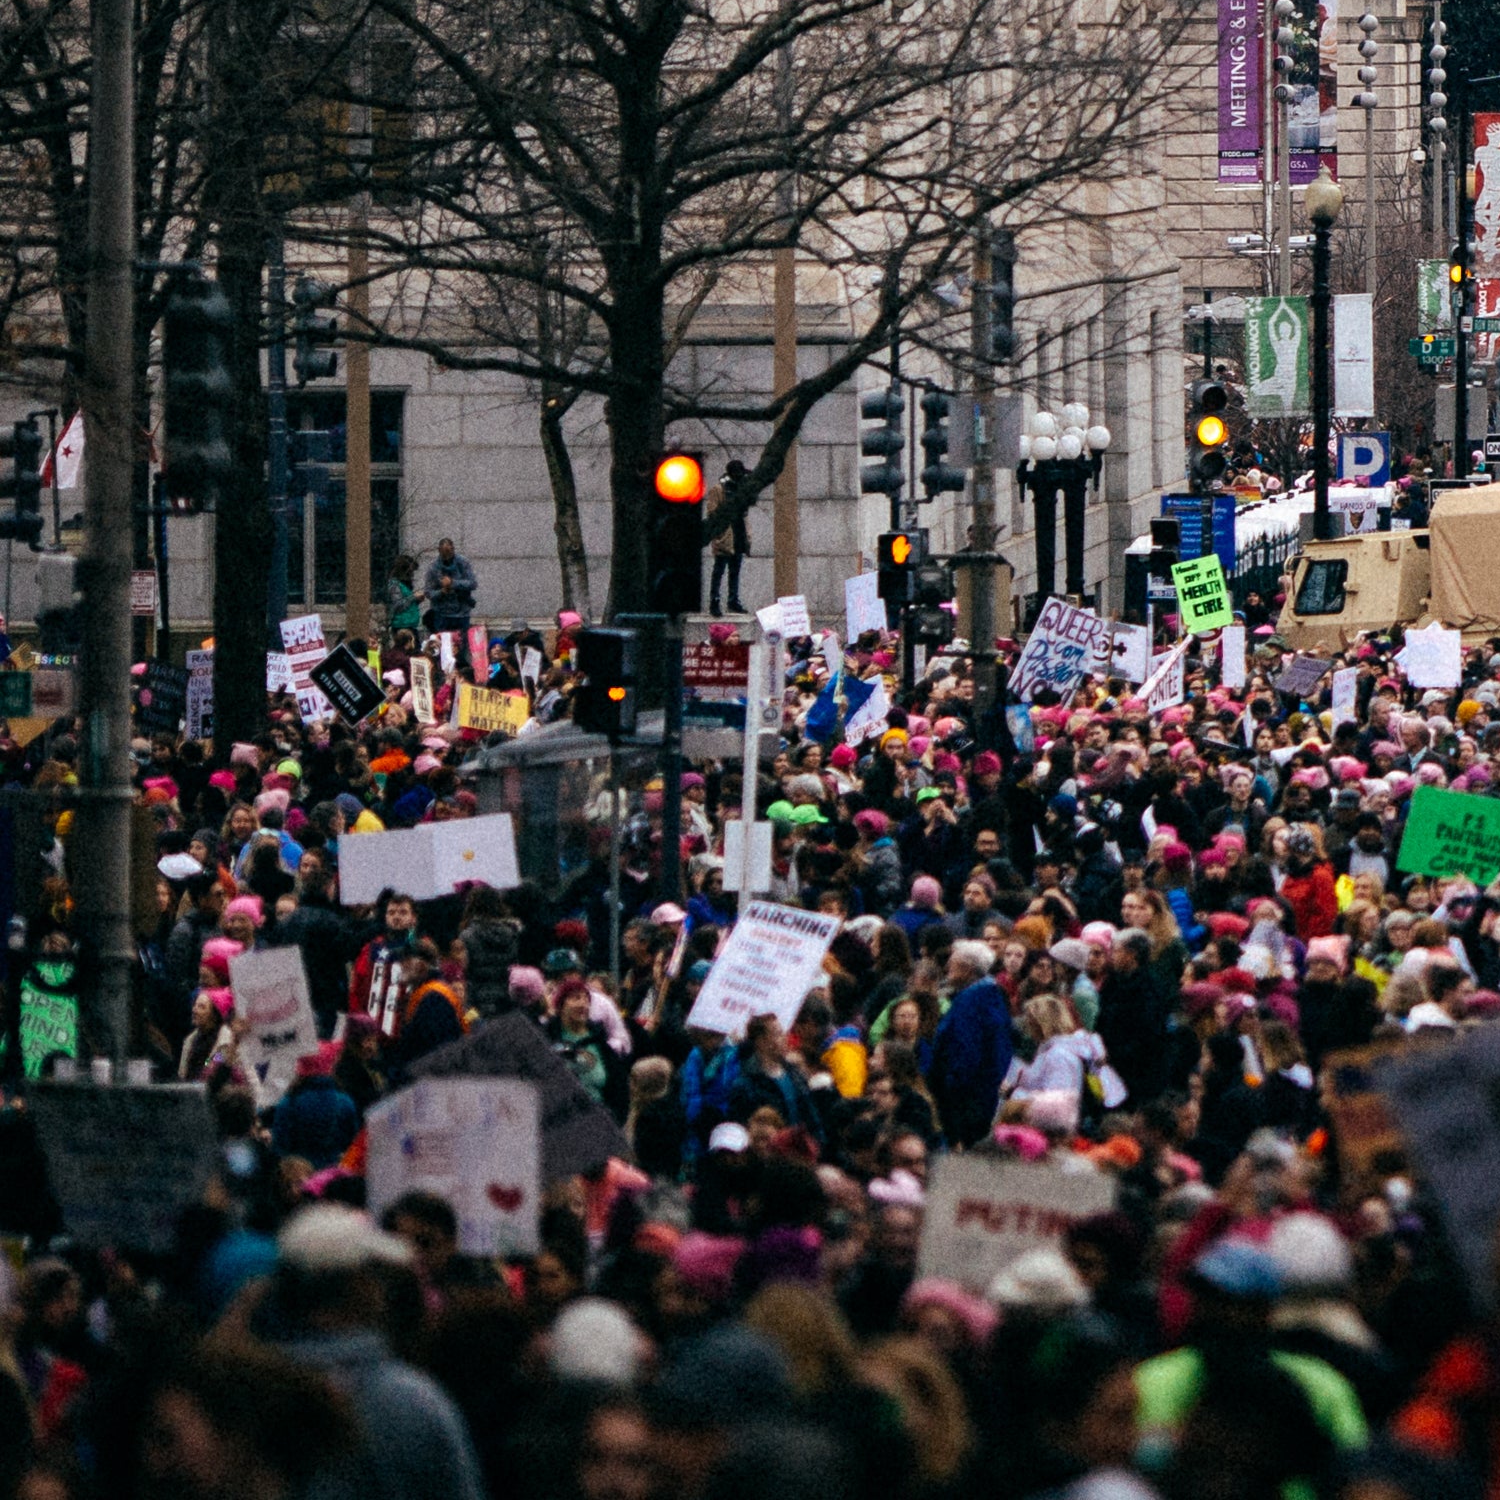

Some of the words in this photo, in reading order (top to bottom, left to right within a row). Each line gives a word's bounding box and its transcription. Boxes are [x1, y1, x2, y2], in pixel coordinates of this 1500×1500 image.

[1230, 12, 1246, 30] &
[1230, 33, 1246, 128] MEETINGS
[1290, 161, 1308, 169] GSA
[1248, 318, 1260, 390] DOWNTOWN
[1422, 341, 1433, 354] D
[1422, 356, 1444, 365] 1300
[1343, 436, 1386, 482] P
[1341, 501, 1368, 511] HANDS
[1184, 573, 1201, 585] OFF
[1206, 568, 1218, 579] MY
[1181, 581, 1221, 603] HEALTH
[1193, 599, 1224, 618] CARE
[1039, 602, 1103, 650] QUEER
[471, 688, 511, 707] BLACK
[468, 715, 518, 737] MATTER
[845, 718, 888, 746] OVEMENT
[747, 905, 832, 939] MARCHING
